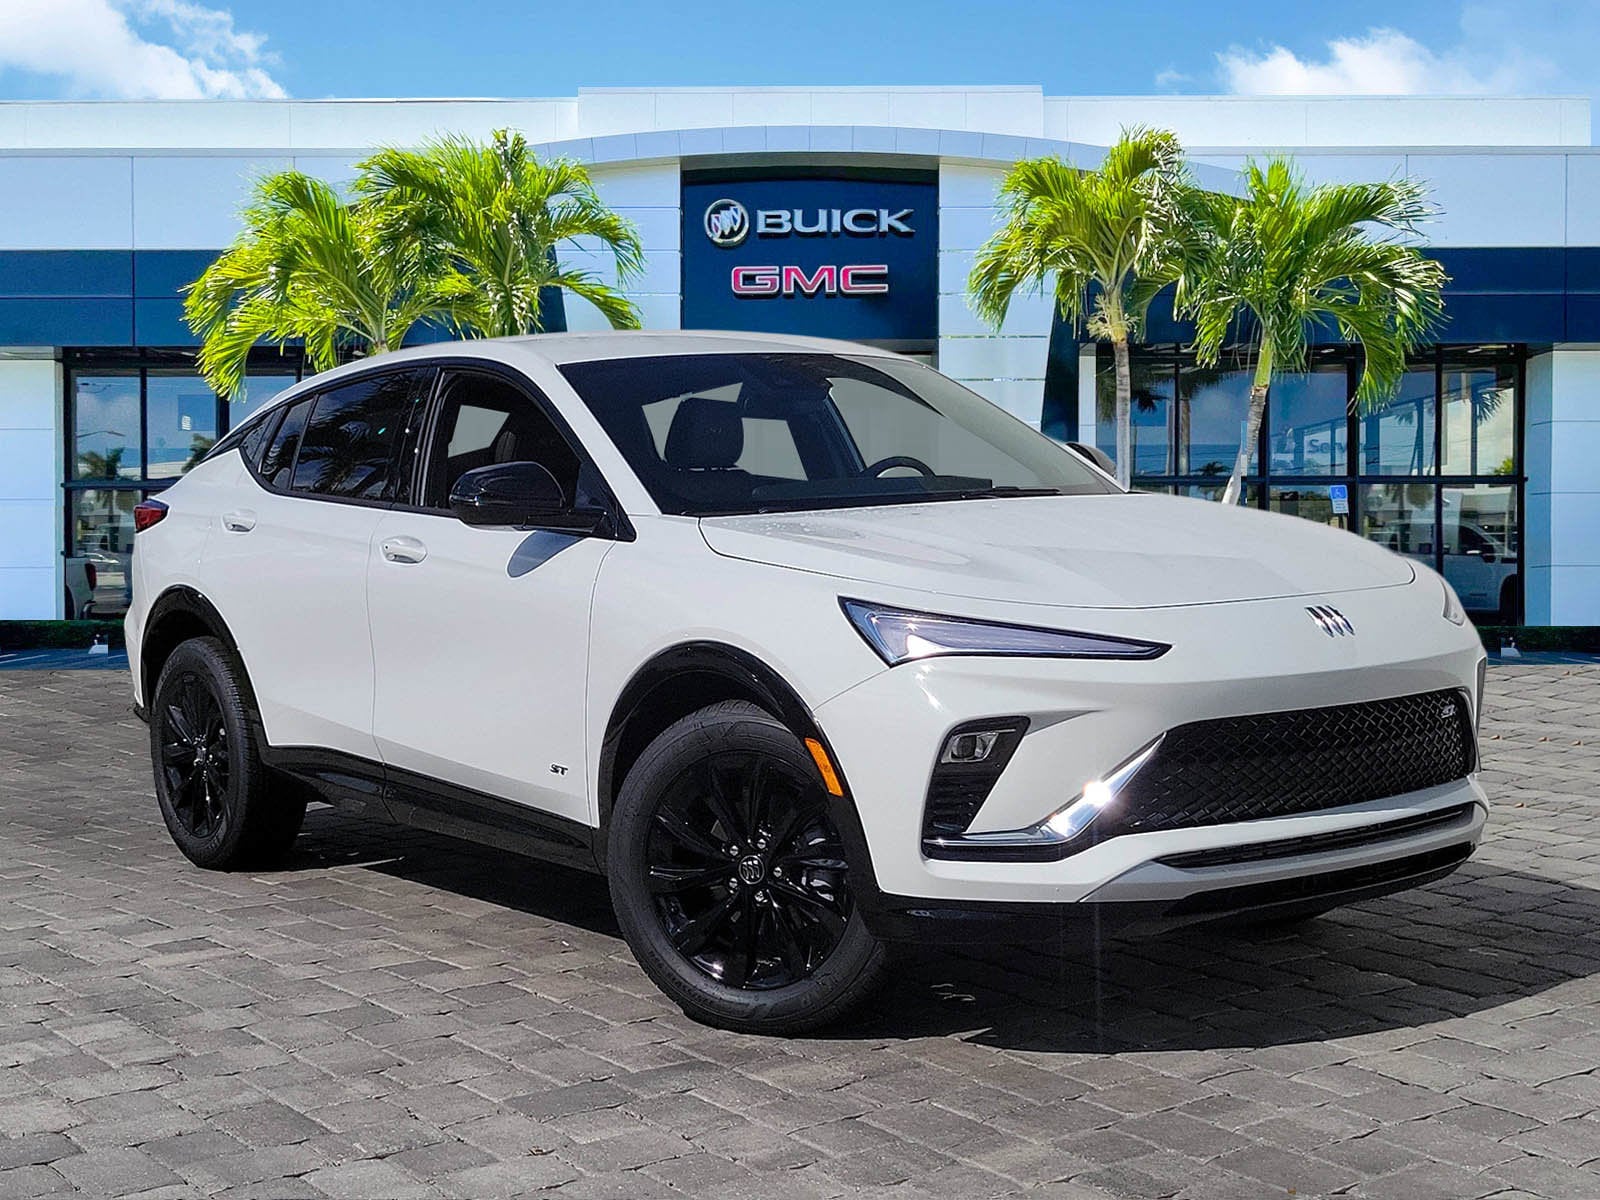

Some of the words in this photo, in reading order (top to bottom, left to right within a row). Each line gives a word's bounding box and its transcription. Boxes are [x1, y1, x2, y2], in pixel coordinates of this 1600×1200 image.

[756, 208, 915, 233] BUICK
[731, 264, 889, 294] GMC
[550, 763, 569, 776] ST
